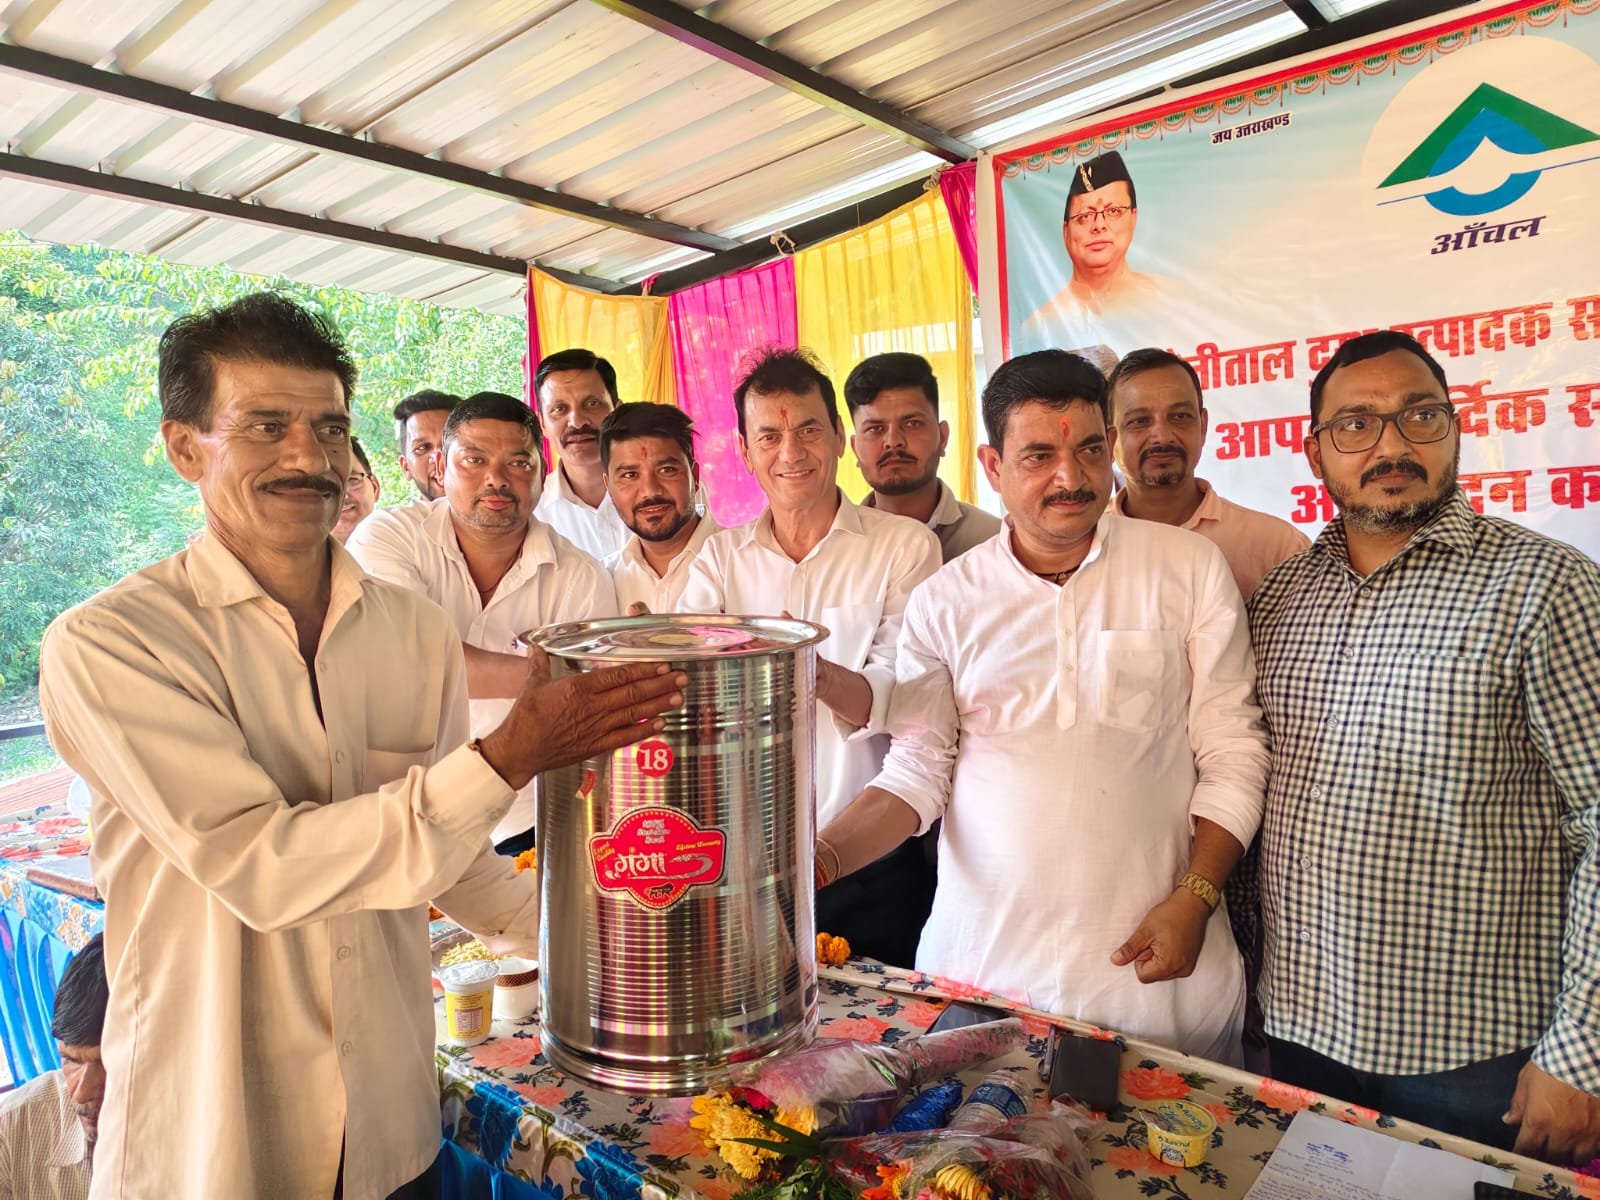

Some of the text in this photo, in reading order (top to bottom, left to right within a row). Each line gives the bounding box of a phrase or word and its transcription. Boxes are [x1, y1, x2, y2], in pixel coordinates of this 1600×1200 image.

[1211, 112, 1290, 145] जय उत्तराखण्ड
[1430, 215, 1547, 255] आँचल
[1166, 342, 1297, 391] नीताल
[1215, 415, 1312, 460] आप
[638, 748, 669, 771] 18
